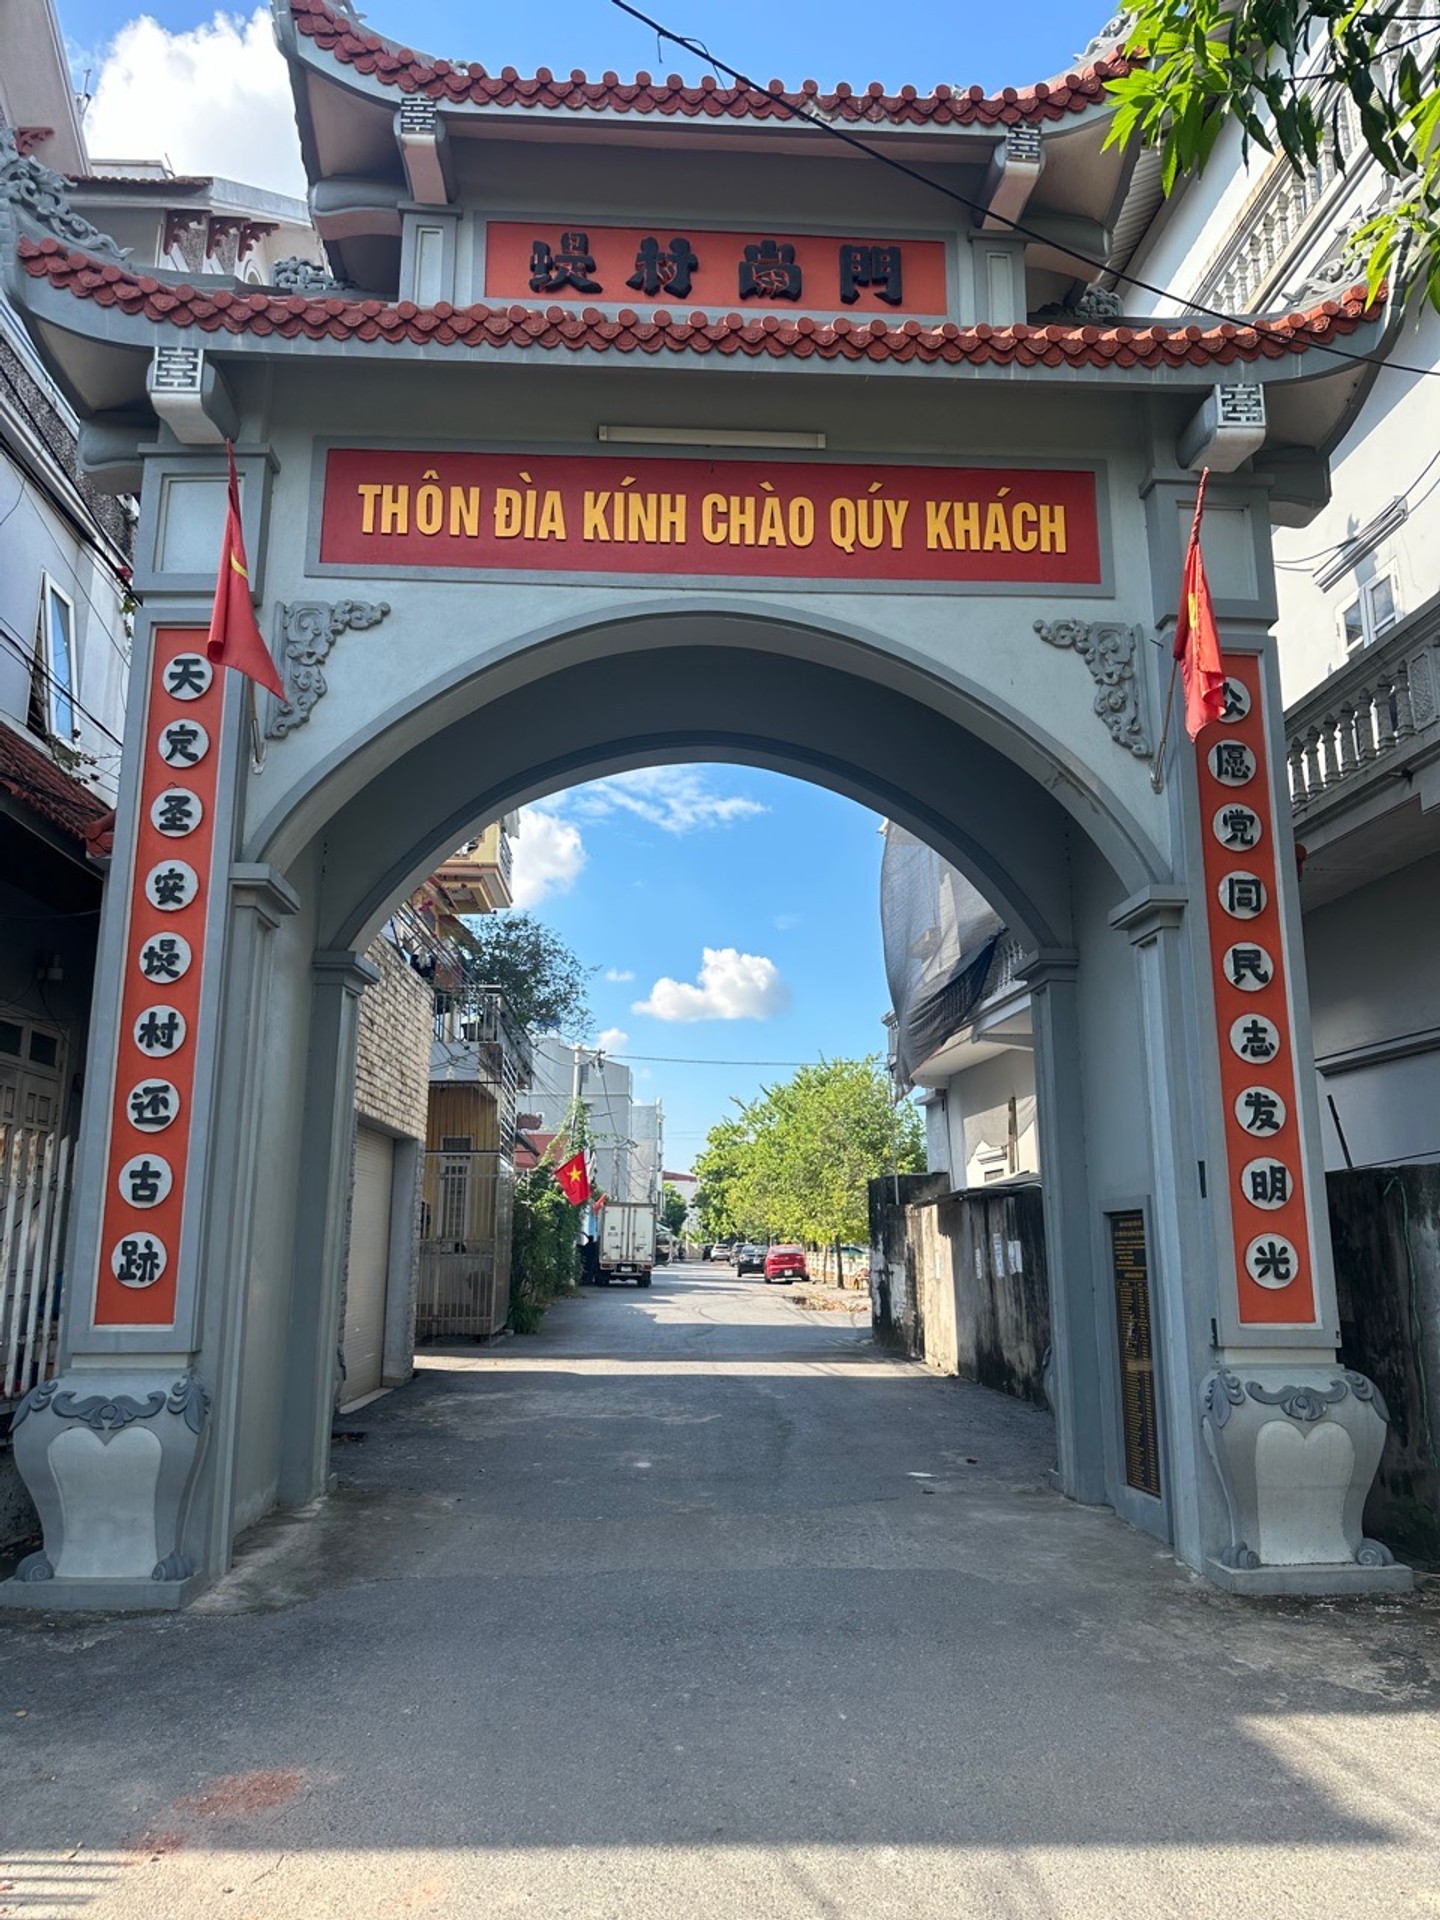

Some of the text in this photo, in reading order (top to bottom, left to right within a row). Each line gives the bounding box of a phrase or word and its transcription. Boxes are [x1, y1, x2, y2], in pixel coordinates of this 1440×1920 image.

[358, 469, 1068, 554] THÔN ĐÌA KÍNH CHÀO QÚY KHÁCH
